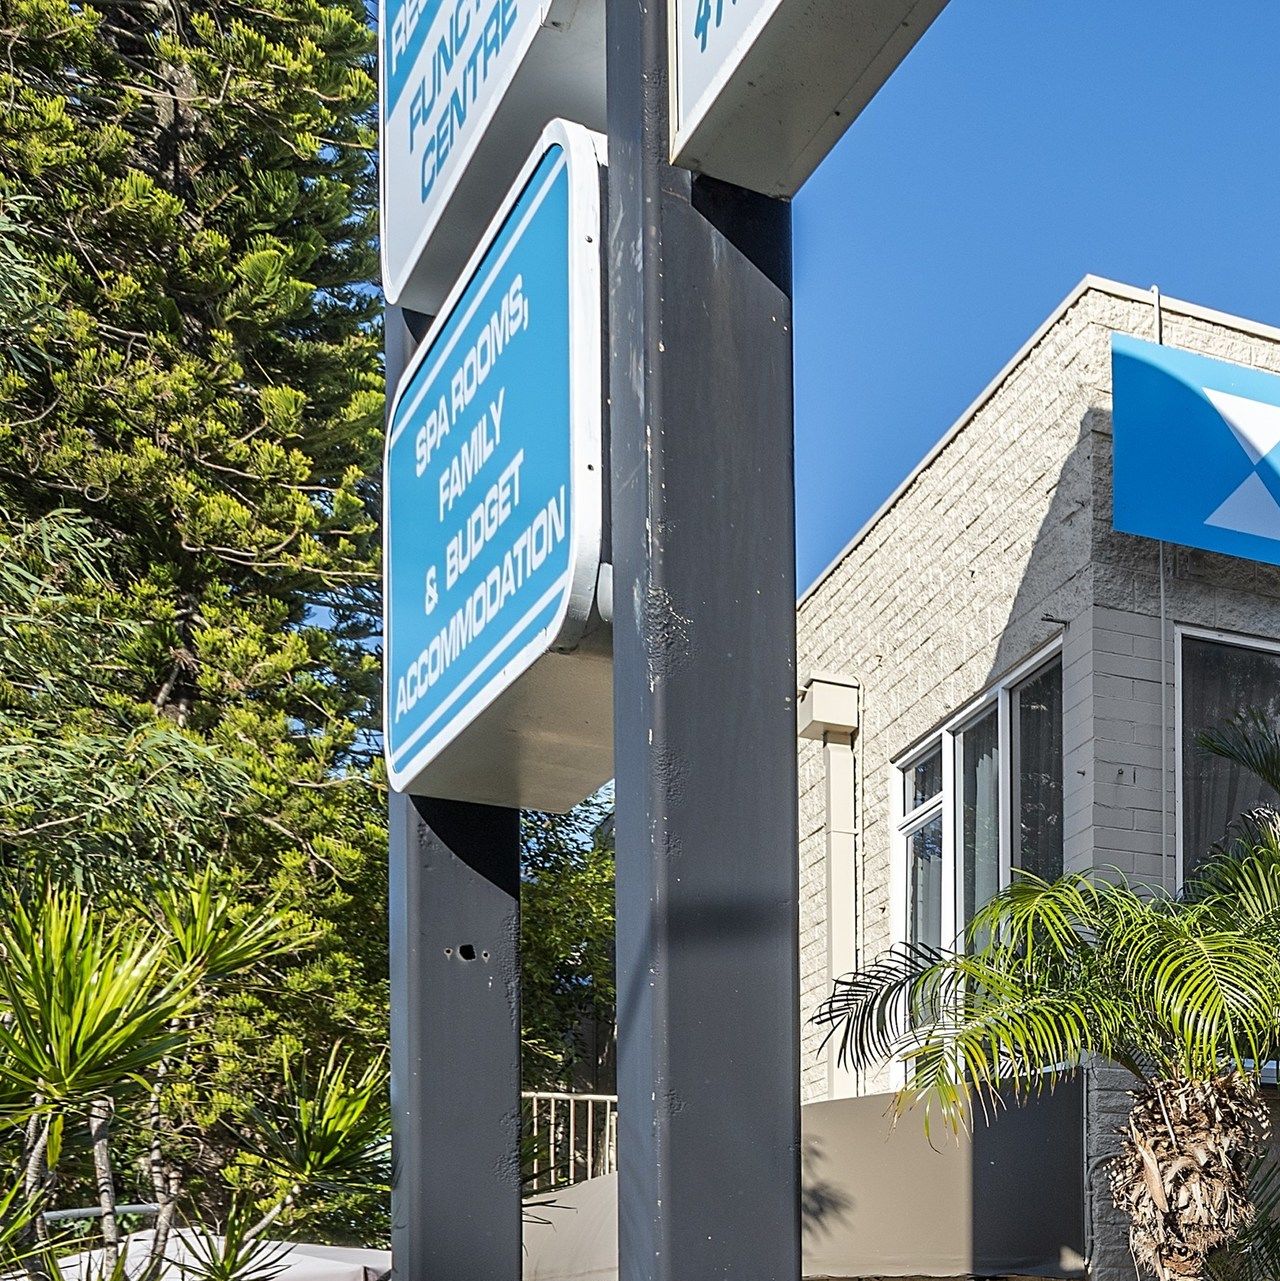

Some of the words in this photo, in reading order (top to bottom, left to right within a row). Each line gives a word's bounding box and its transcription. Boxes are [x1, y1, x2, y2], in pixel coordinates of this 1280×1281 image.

[409, 0, 482, 155] FUNC
[421, 0, 518, 204] CENTRE
[415, 394, 450, 478] SPA
[451, 273, 529, 425] ROOMS,
[439, 386, 505, 523] FAMILY
[394, 484, 566, 724] ACCOMMODATION
[425, 565, 439, 616] &
[446, 448, 524, 591] BUDGET
